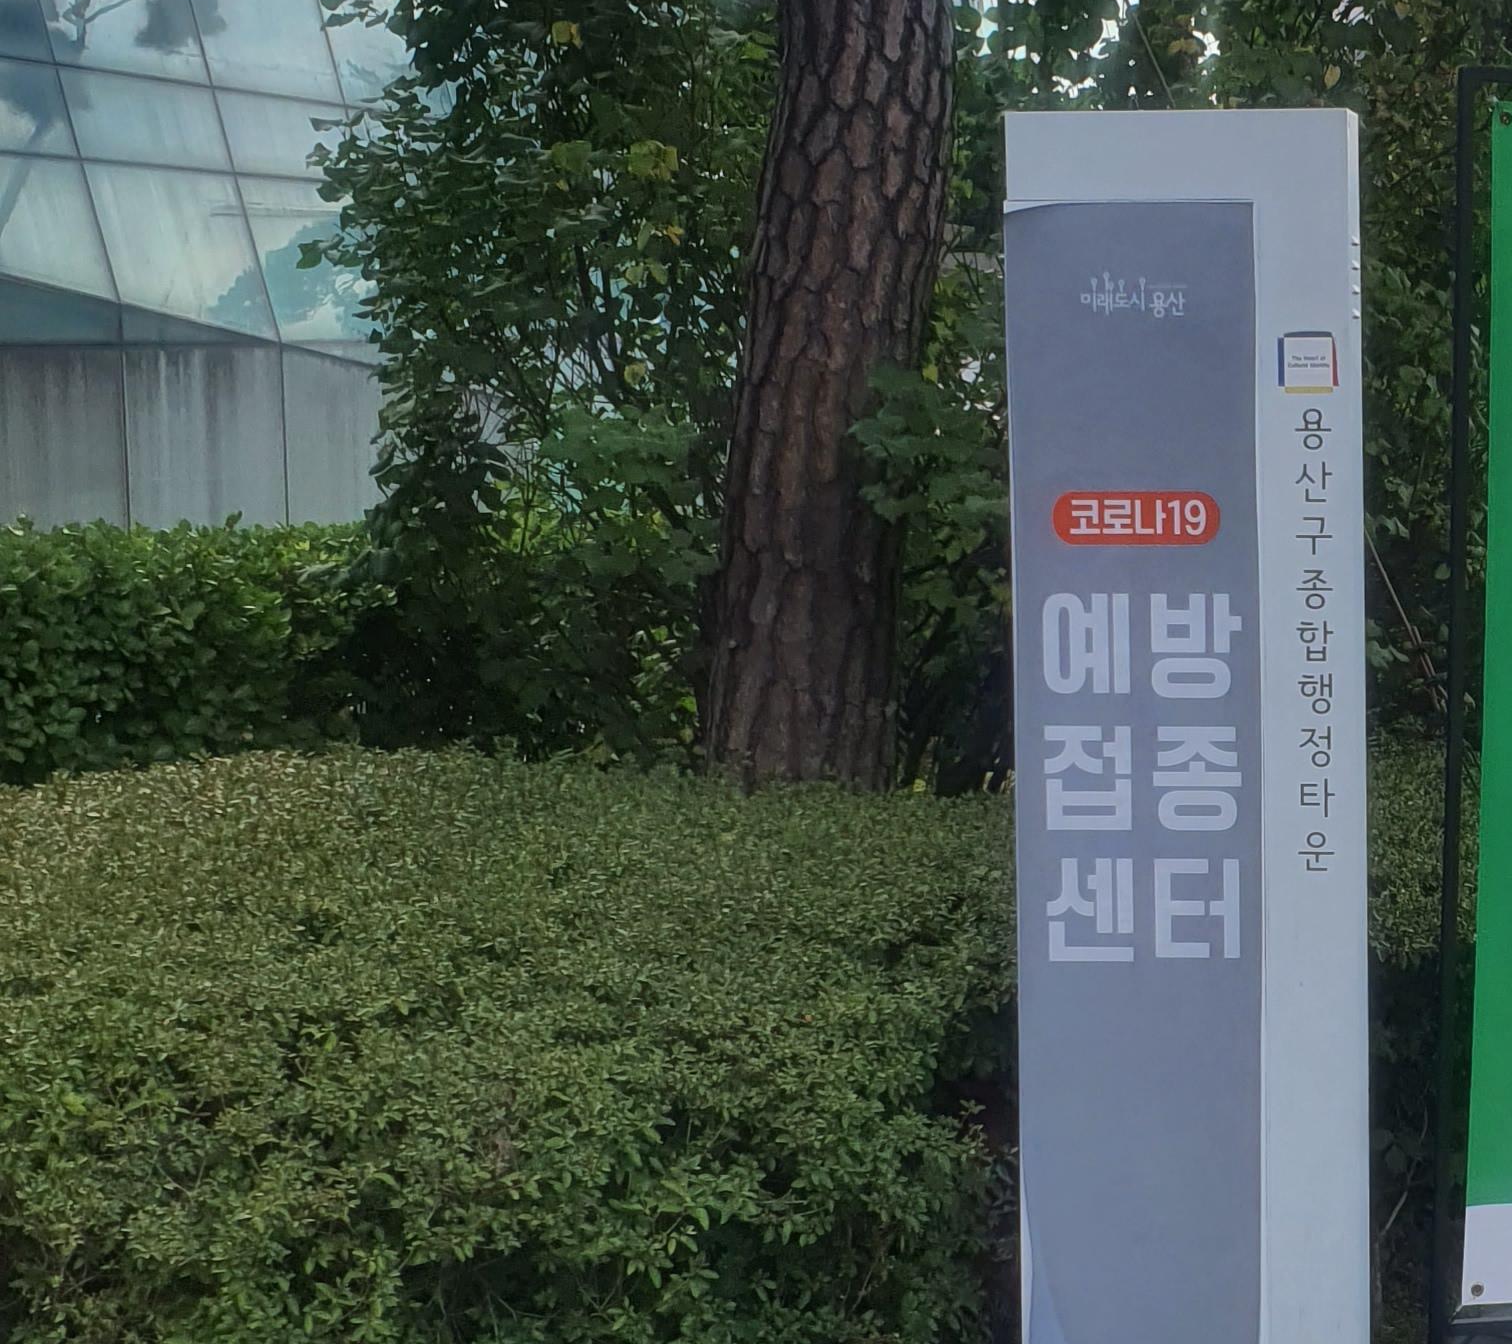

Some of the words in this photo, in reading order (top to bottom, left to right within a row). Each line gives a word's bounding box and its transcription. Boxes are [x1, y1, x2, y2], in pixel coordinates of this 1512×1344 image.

[1080, 271, 1146, 316] 미래도시
[1149, 291, 1186, 318] 용산
[1069, 498, 1207, 537] 코로나19
[1042, 592, 1243, 699] 예방
[1043, 725, 1243, 832] 접종
[1045, 857, 1241, 963] 센터
